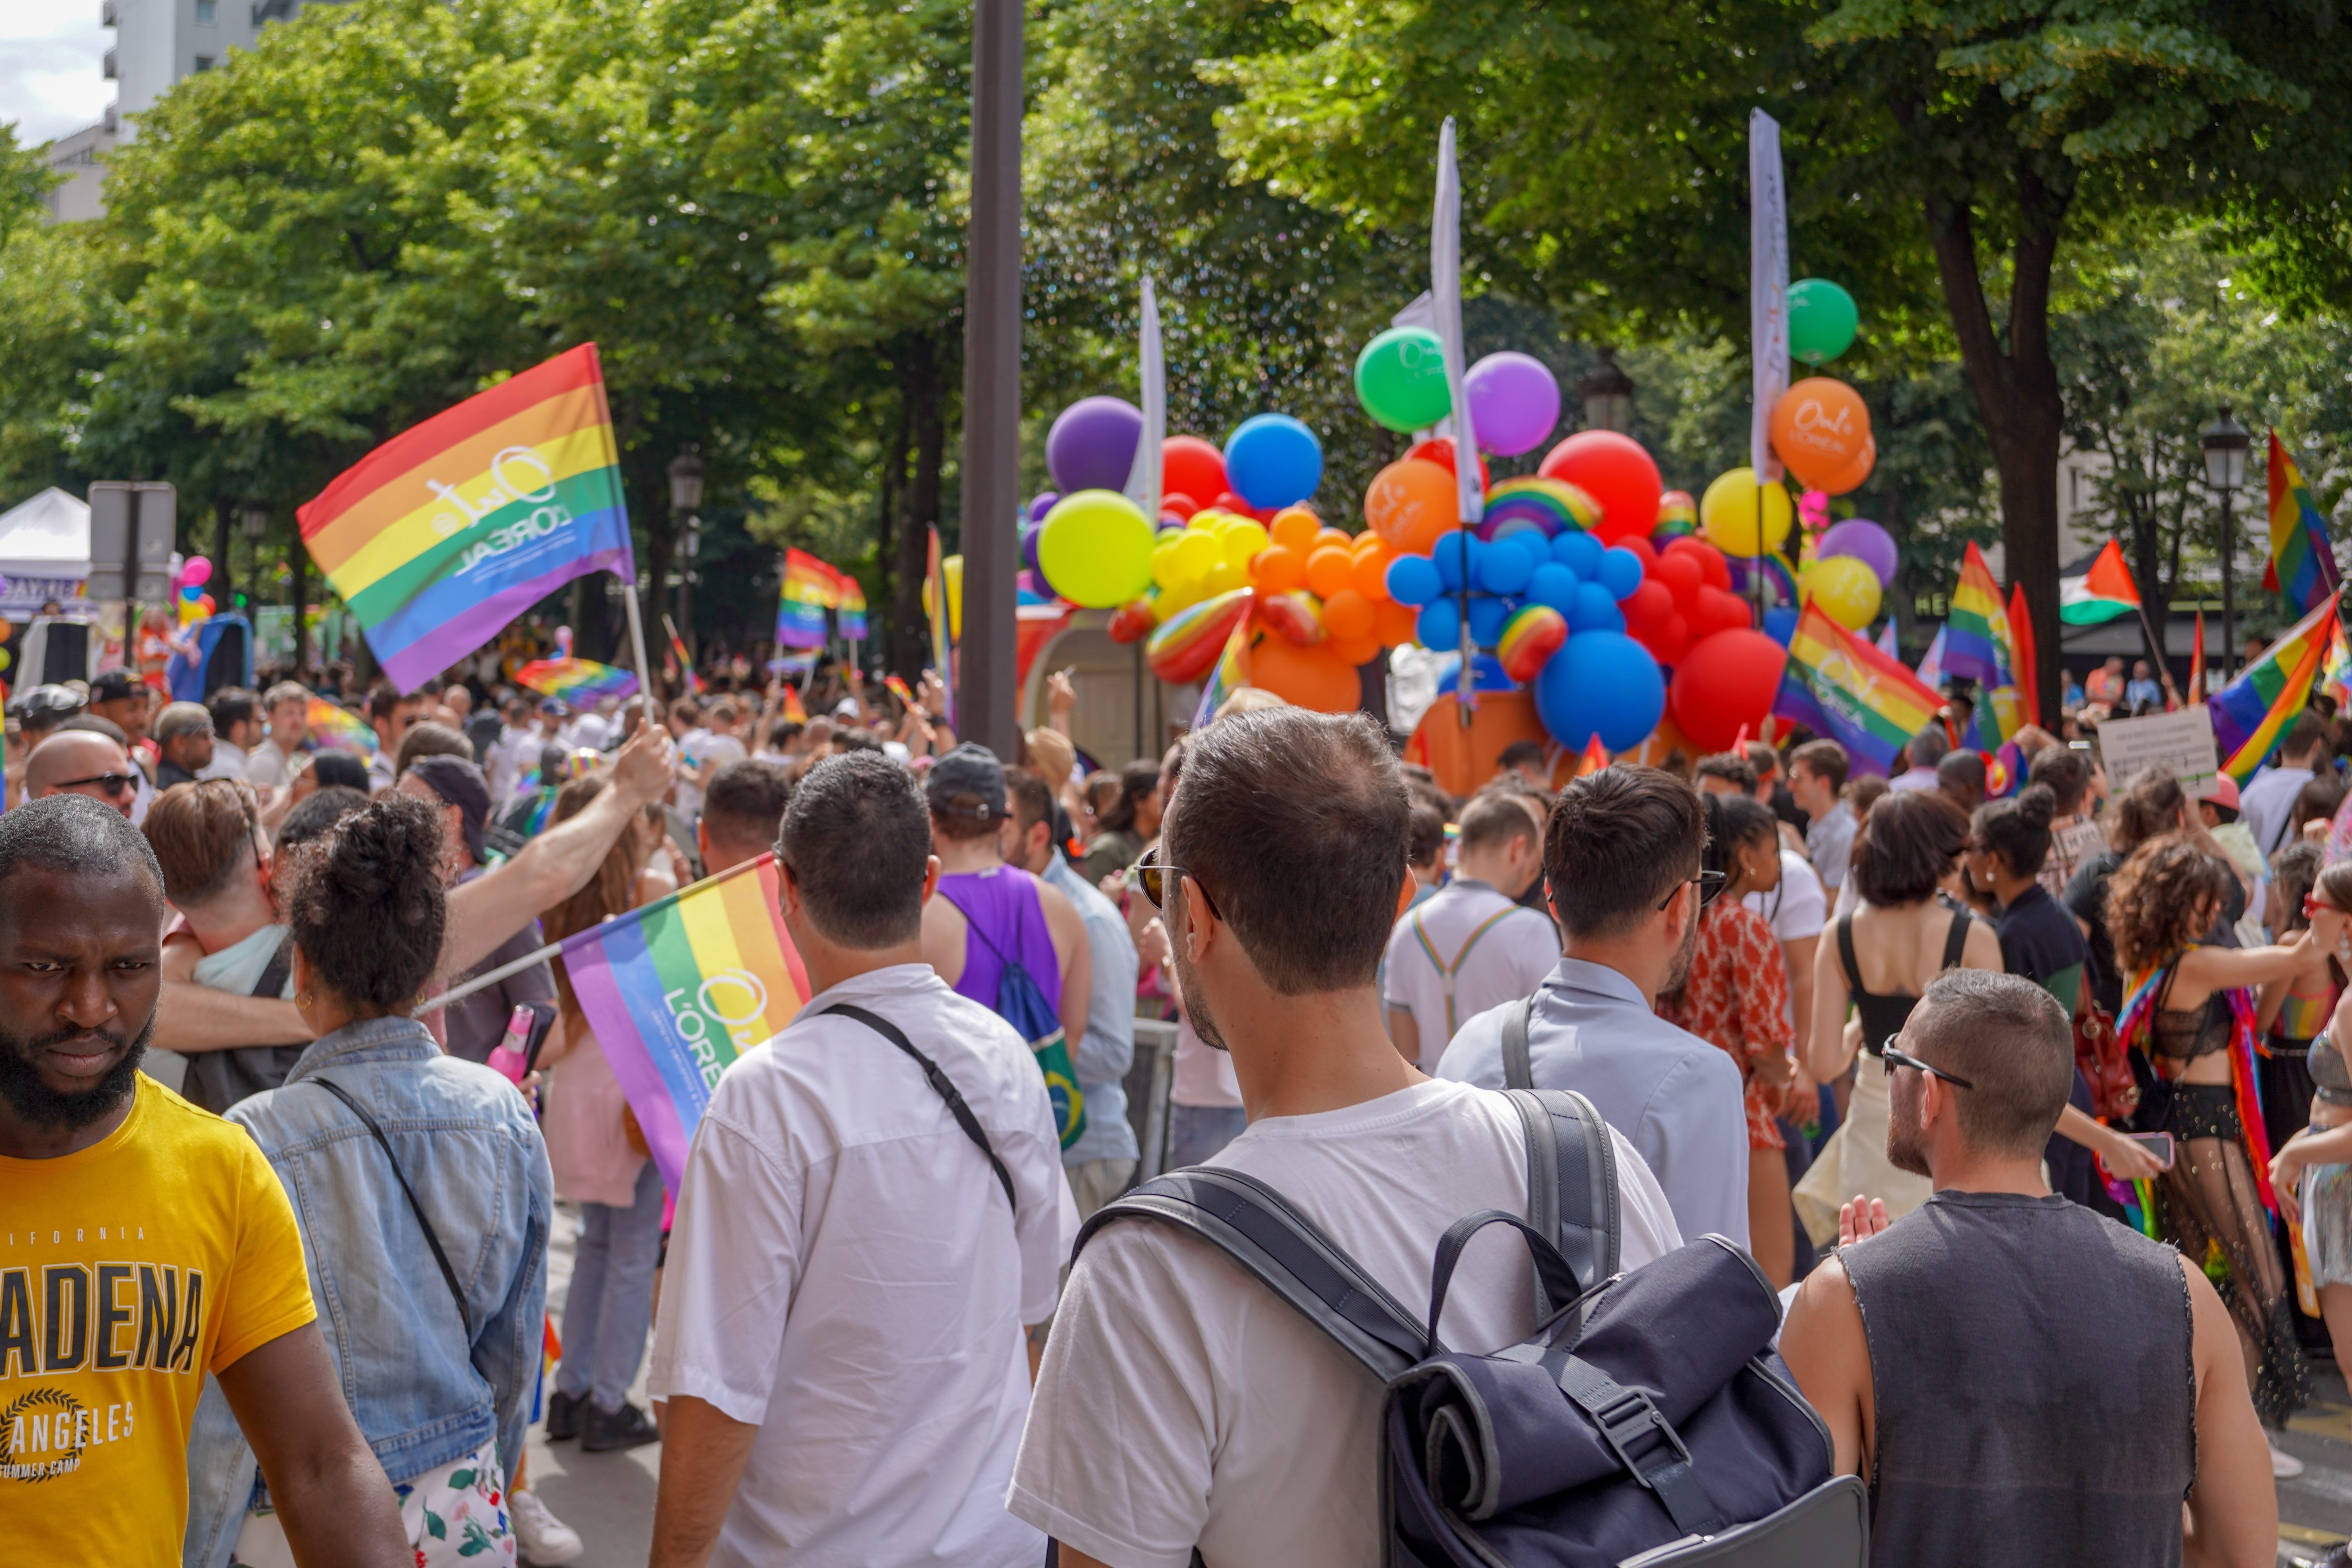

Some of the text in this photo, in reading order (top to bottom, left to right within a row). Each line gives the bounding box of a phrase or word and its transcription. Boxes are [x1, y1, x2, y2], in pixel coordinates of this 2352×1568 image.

[1793, 399, 1850, 434] Out
[1915, 593, 1954, 616] HE
[9, 1227, 144, 1246] IFORNIA
[0, 1261, 204, 1380] ADENA
[8, 1401, 134, 1454] ANGELES
[50, 1458, 81, 1475] CAMP
